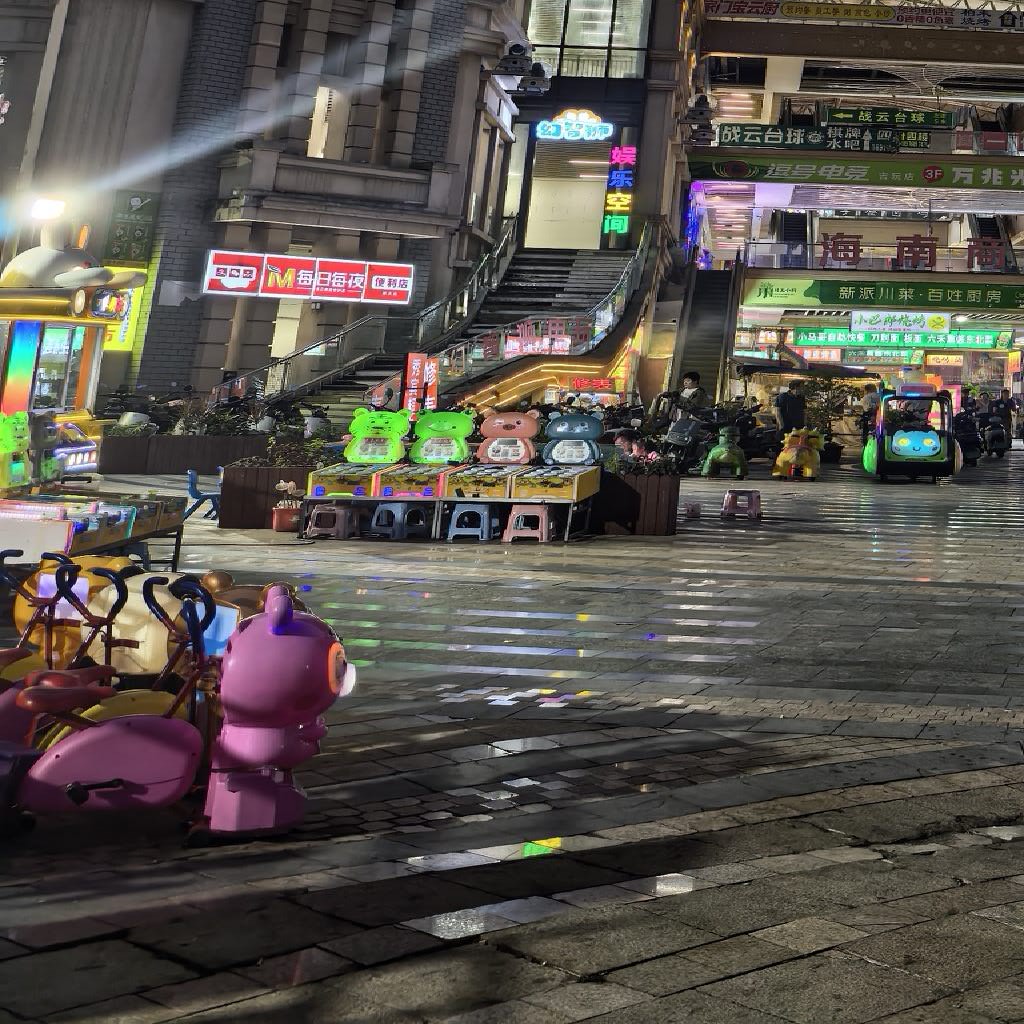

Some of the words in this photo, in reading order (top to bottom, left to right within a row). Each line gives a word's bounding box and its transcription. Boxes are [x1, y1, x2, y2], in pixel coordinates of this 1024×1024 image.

[859, 111, 925, 123] 战云台球
[720, 127, 805, 145] 战云台球
[827, 127, 861, 138] 棋牌
[827, 138, 861, 150] 水吧
[925, 169, 943, 179] 3F
[604, 146, 637, 234] 娱乐空间
[297, 270, 365, 288] 每日每夜
[375, 277, 408, 288] 便利店
